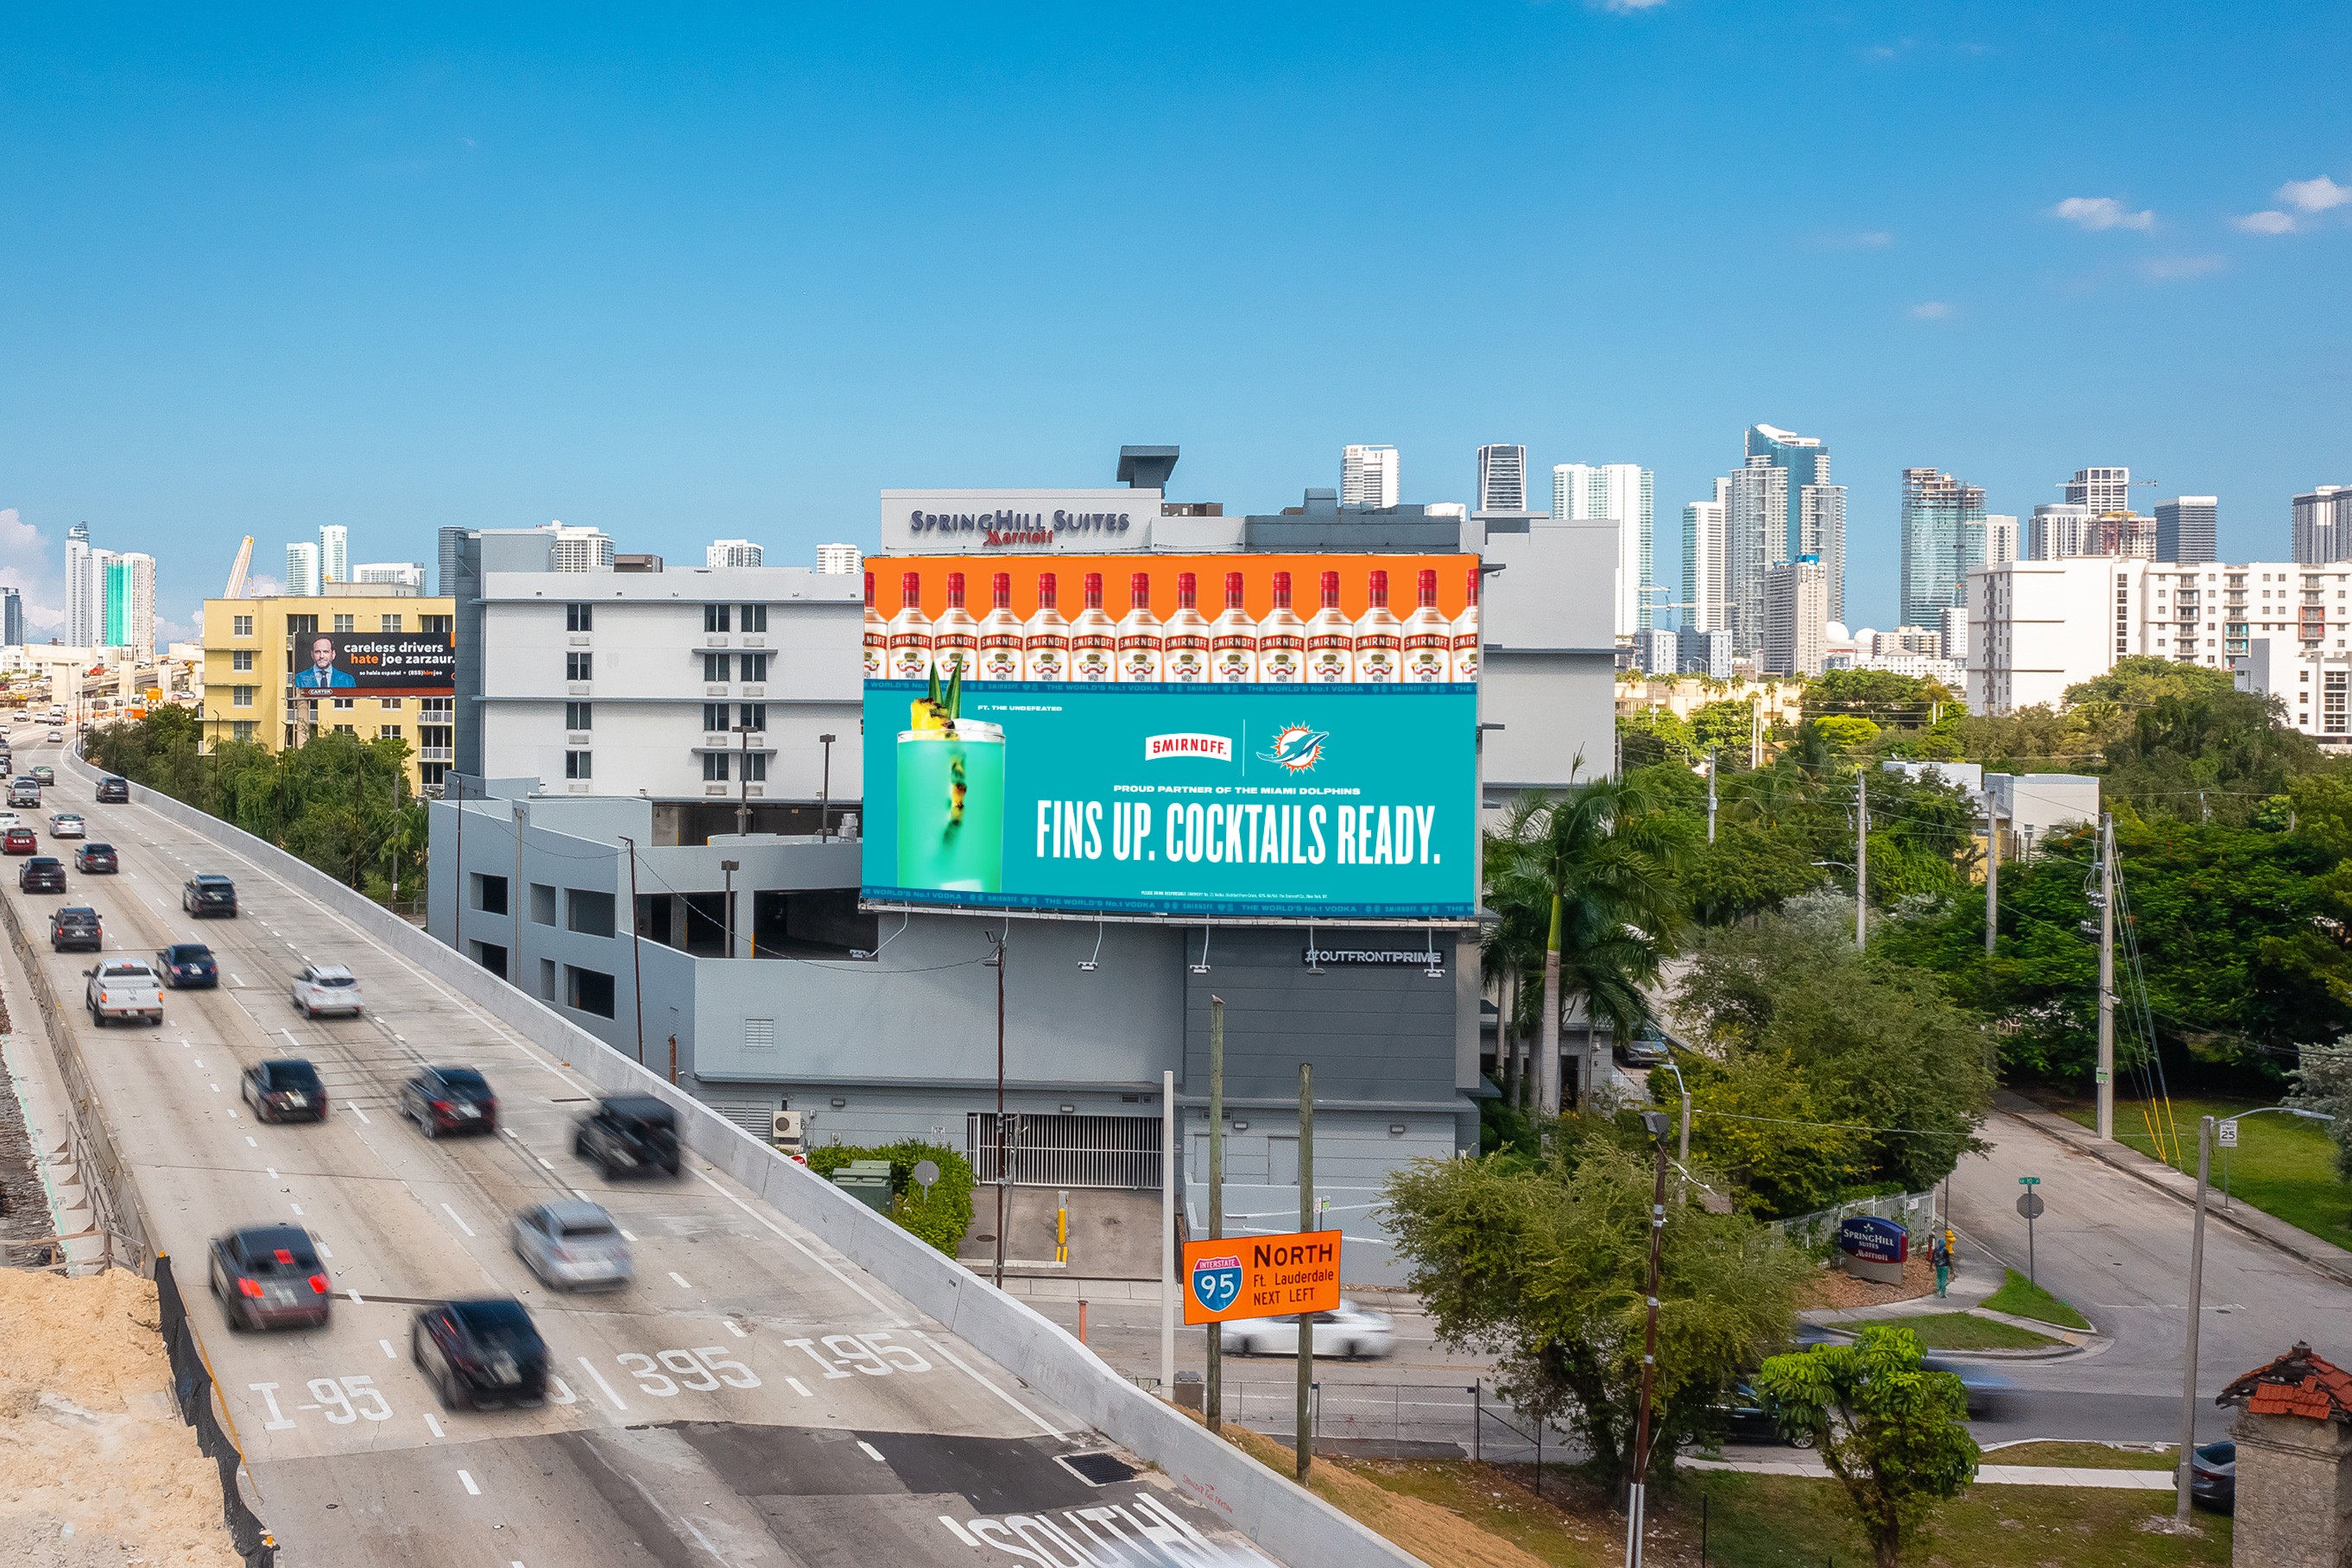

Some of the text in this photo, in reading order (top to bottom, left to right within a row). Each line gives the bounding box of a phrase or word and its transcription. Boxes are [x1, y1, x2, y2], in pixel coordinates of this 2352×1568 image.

[983, 529, 1054, 547] Marriott
[345, 642, 443, 652] careless drivers
[866, 635, 886, 647] NOFF
[891, 635, 931, 647] SMIRNOFF
[936, 635, 976, 648] SMIRNOFF
[982, 636, 1021, 648] SMIRNOFF
[1027, 636, 1067, 648] SMIRNOFF
[1073, 636, 1114, 648] SMIRNOFF
[1120, 637, 1160, 648] SMIRNOFF
[1167, 637, 1208, 648] SMIRNOFF
[1213, 637, 1255, 648] SMIRNOFF
[1261, 637, 1303, 648] SMIRNOFF
[1309, 637, 1350, 648] SMIRNOFF
[1357, 637, 1399, 648] SMIRNOFF
[1406, 636, 1448, 648] SMIRNOFF
[1455, 636, 1476, 648] SMIR
[351, 654, 455, 667] hate joe zarzaur.
[1037, 800, 1440, 864] FINS UP. COCKTAILS READY.
[1305, 950, 1441, 963] #OUTFRONTPRIME
[2222, 1131, 2235, 1139] 25
[1254, 1244, 1333, 1268] NORTH
[1856, 1249, 1888, 1261] Marriott
[1199, 1258, 1235, 1269] INTERSTATE
[1254, 1269, 1334, 1287] Ft. Lauderdale
[1201, 1274, 1234, 1299] 95
[1254, 1287, 1315, 1306] NEXT LEFT
[783, 1332, 932, 1379] I-95
[616, 1346, 762, 1397] 395
[249, 1375, 394, 1430] I-95
